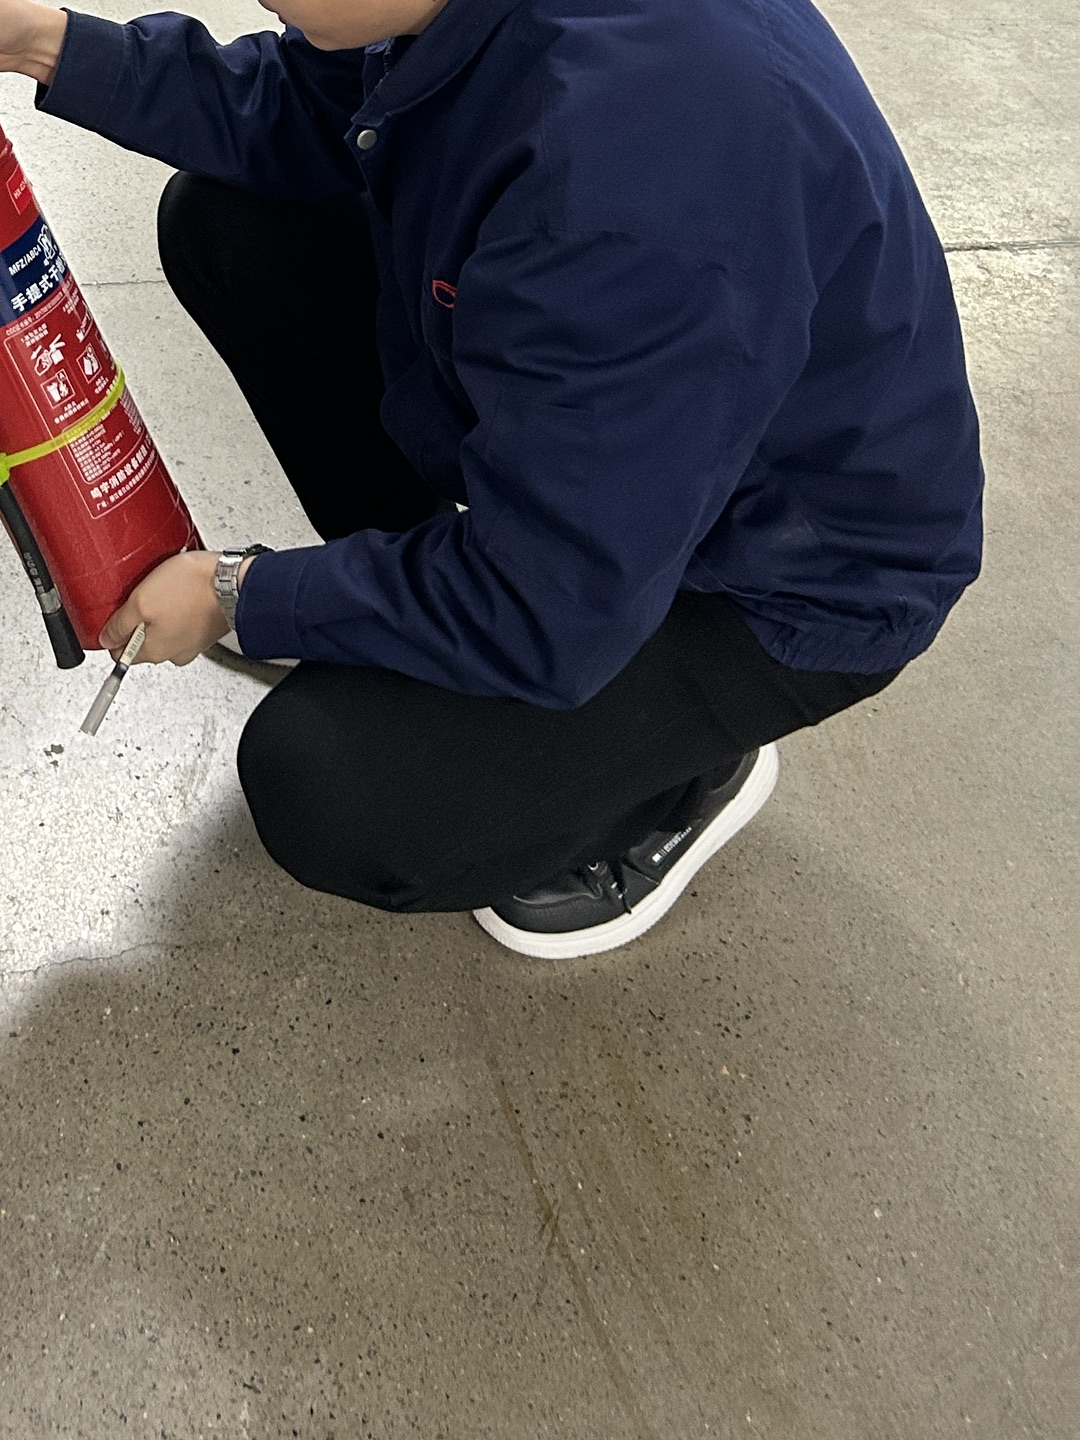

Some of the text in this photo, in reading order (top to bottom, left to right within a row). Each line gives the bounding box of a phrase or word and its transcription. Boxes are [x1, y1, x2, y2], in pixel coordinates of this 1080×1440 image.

[11, 251, 68, 311] 手提式干粉
